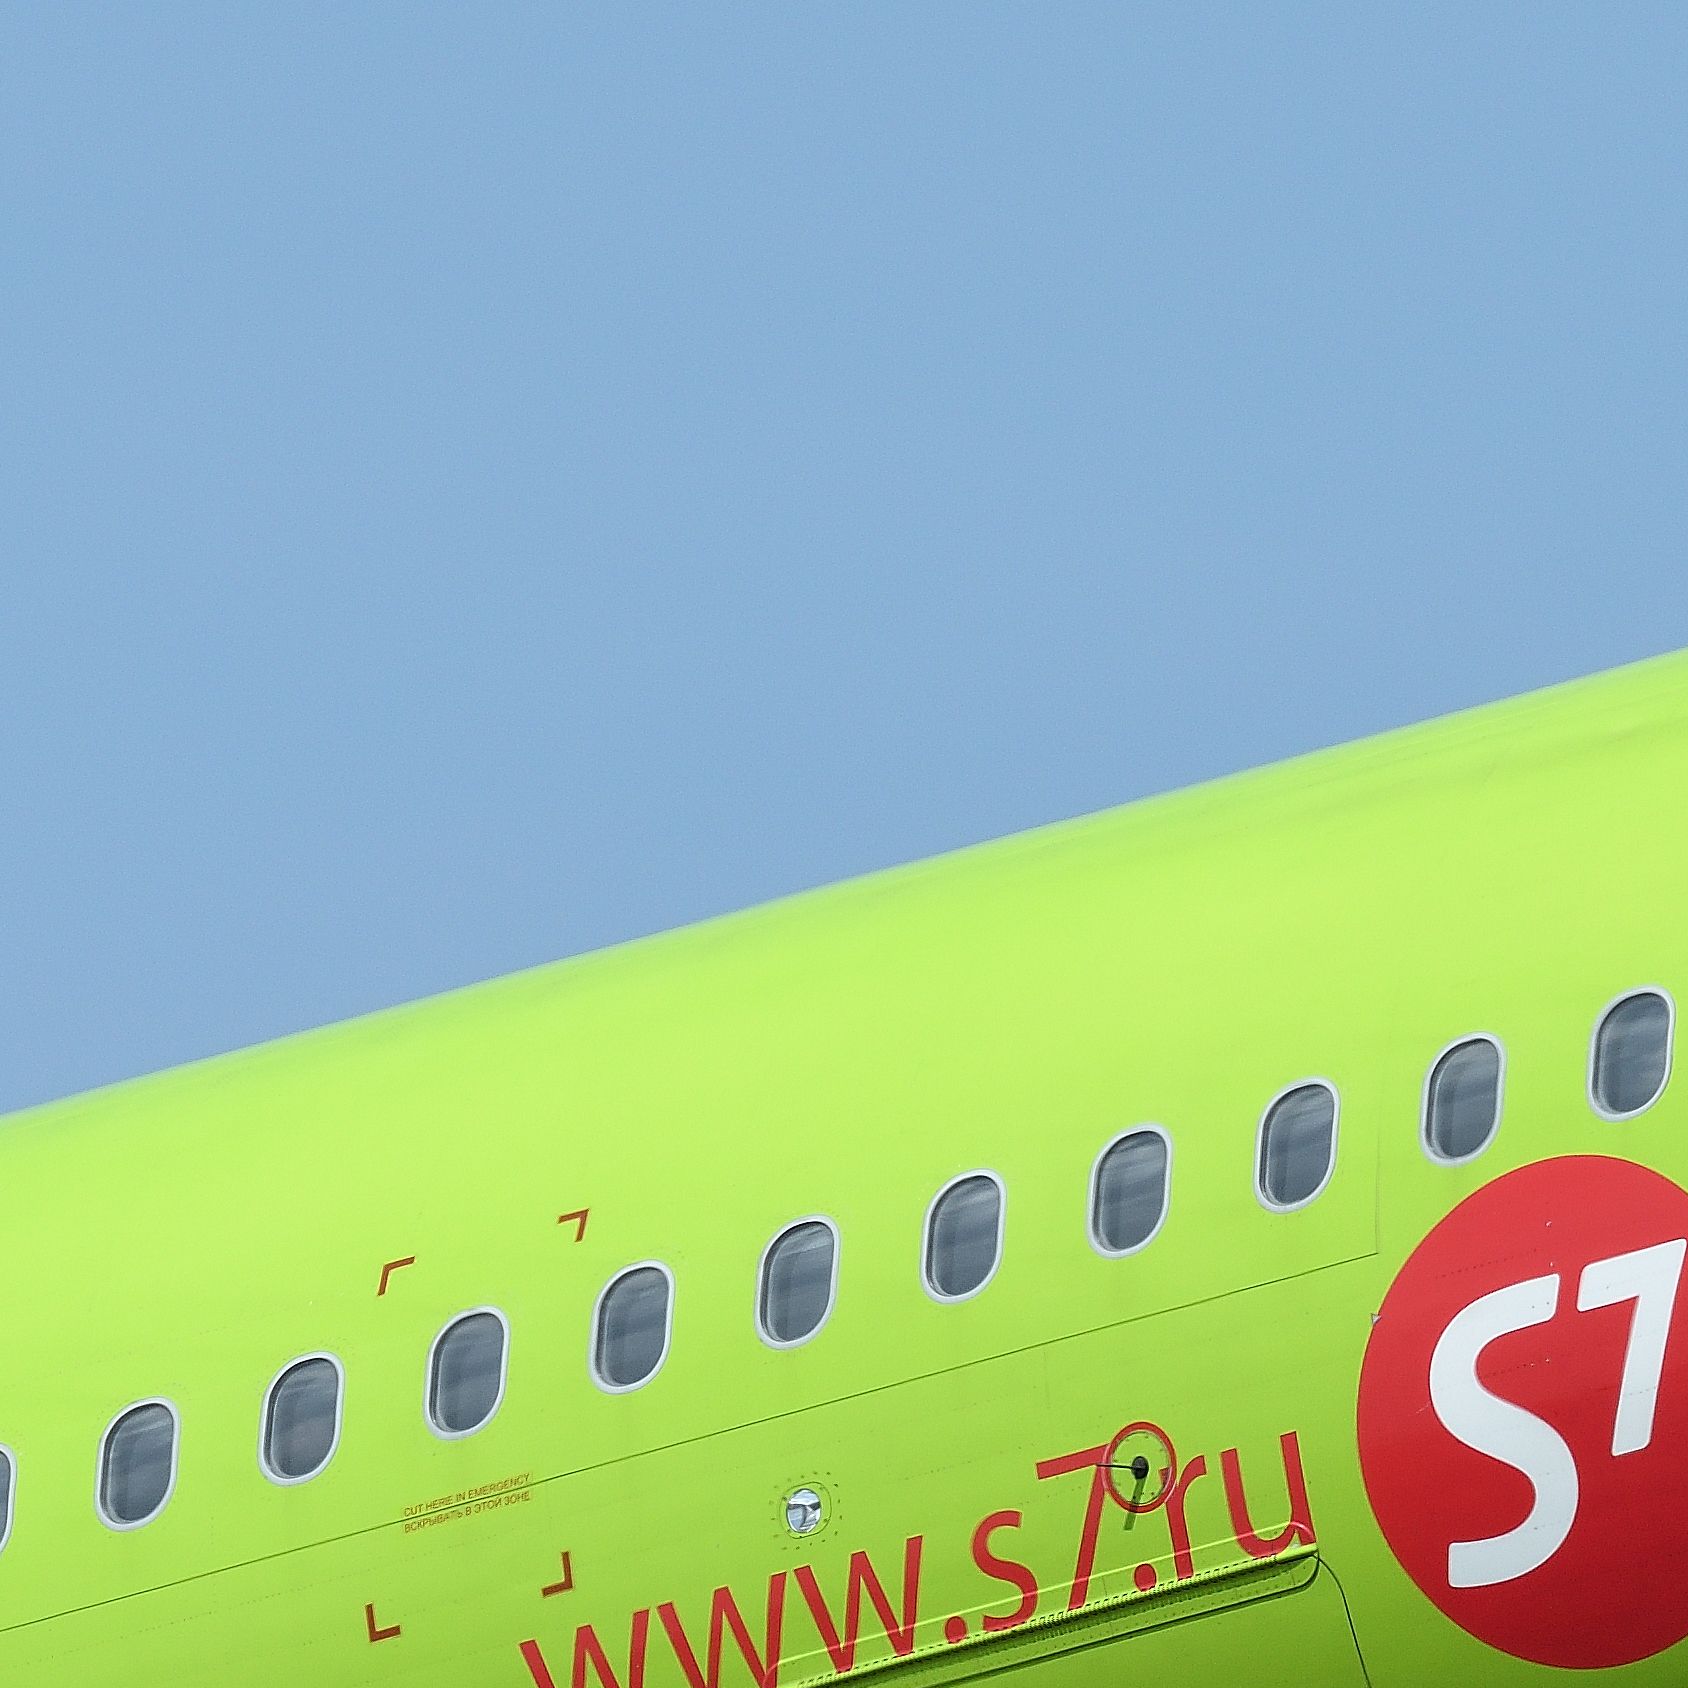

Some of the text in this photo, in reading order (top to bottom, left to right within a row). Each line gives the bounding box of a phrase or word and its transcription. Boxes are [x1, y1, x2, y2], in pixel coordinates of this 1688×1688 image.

[1429, 1238, 1688, 1589] S7
[404, 1472, 530, 1517] CUT HERE IN EMERGENCY
[404, 1490, 530, 1534] ВСКРЫВАТЬ В ЭТОЙ ЗОНЕ
